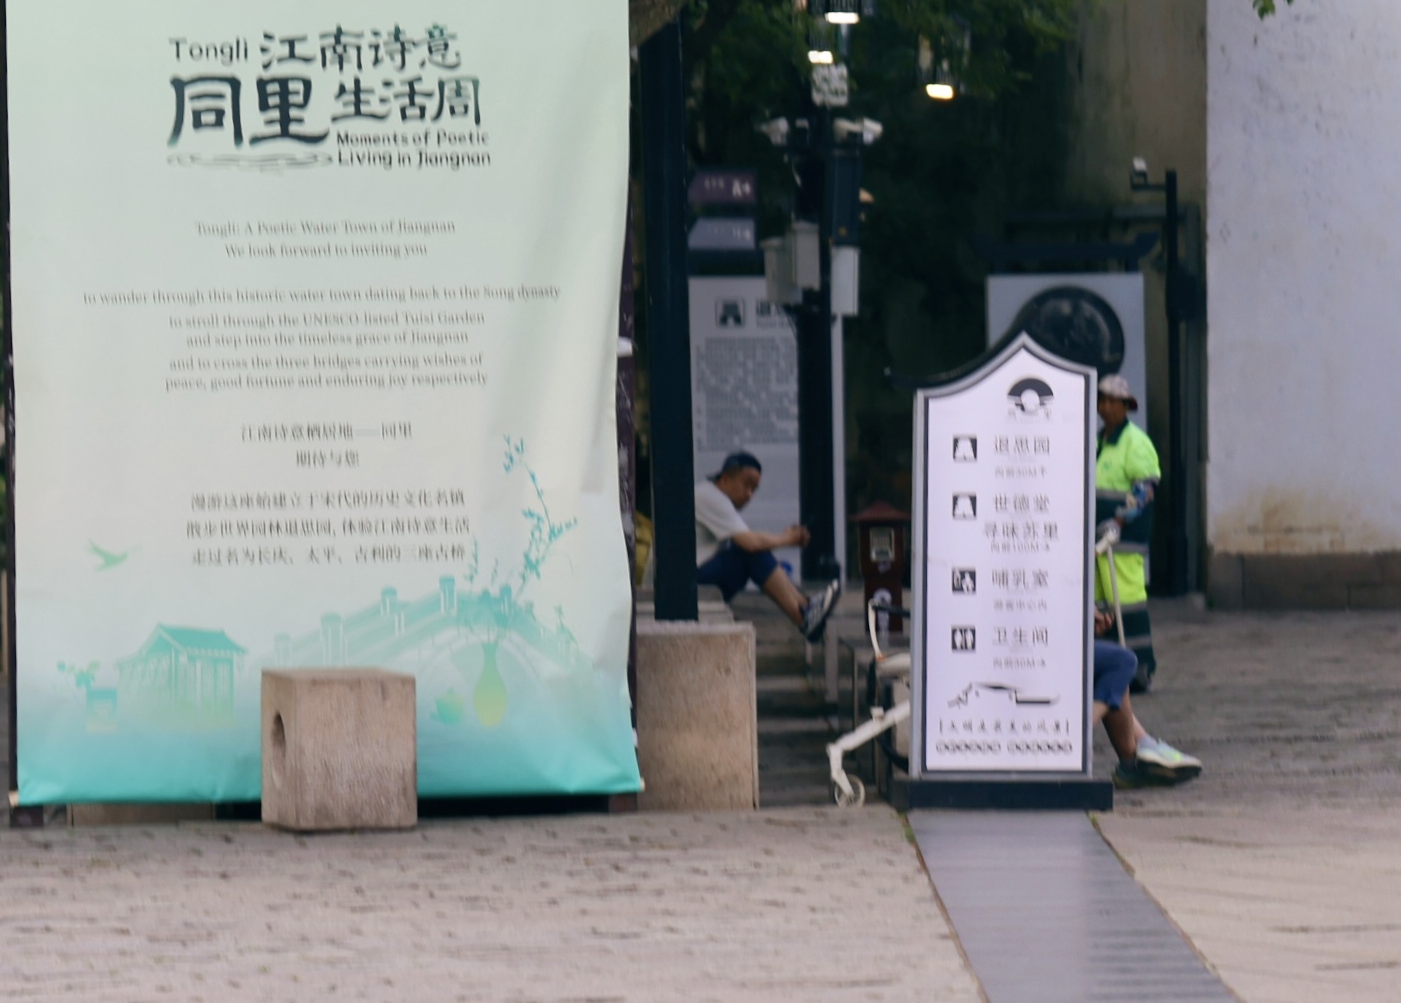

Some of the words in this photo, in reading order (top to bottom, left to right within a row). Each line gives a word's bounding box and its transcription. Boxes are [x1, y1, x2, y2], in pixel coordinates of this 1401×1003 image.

[169, 36, 248, 65] Tongli
[259, 24, 461, 72] 江南诗意
[168, 74, 330, 147] 同里
[331, 74, 481, 126] 生活周
[337, 131, 408, 147] Moments
[413, 130, 430, 146] of
[437, 129, 489, 146] Poetic
[339, 149, 393, 169] Living
[398, 151, 411, 166] in
[418, 149, 491, 169] Jiangnan
[196, 221, 239, 238] Tongli:
[245, 222, 253, 235] A
[258, 222, 296, 235] Poetic
[301, 221, 337, 235] Water
[345, 220, 377, 234] Town
[381, 220, 394, 234] of
[398, 219, 456, 236] Jiangnan
[225, 244, 244, 258] We
[249, 243, 276, 258] look
[280, 243, 331, 258] forward
[335, 245, 348, 257] to
[352, 242, 400, 259] inviting
[404, 245, 427, 258] you
[84, 292, 96, 305] to
[100, 289, 147, 305] wander
[153, 288, 205, 306] through
[209, 288, 233, 303] this
[237, 288, 286, 303] historic
[290, 289, 324, 303] water
[329, 289, 361, 302] town
[365, 286, 406, 303] dating
[410, 285, 439, 300] back
[444, 288, 456, 300] to
[460, 285, 480, 299] the
[484, 285, 514, 302] Song
[518, 283, 560, 302] dynasty
[169, 315, 182, 328] to
[186, 313, 218, 328] stroll
[223, 312, 274, 330] through
[279, 312, 299, 327] the
[303, 312, 360, 326] UNESCO
[364, 310, 399, 326] listed
[403, 311, 434, 325] Tuisi
[438, 310, 485, 325] Garden
[187, 332, 211, 347] and
[215, 334, 242, 350] step
[246, 332, 271, 346] into
[275, 331, 295, 346] the
[299, 330, 352, 346] timeless
[356, 332, 390, 347] grace
[394, 330, 407, 344] of
[411, 329, 469, 346] Jiangnan
[170, 355, 194, 371] and
[198, 357, 211, 370] to
[214, 359, 247, 370] cross
[252, 354, 272, 369] the
[276, 353, 310, 369] three
[314, 353, 361, 370] bridges
[365, 354, 419, 369] carrying
[423, 351, 466, 368] wishes
[470, 352, 483, 366] of
[165, 376, 207, 393] peace,
[211, 374, 242, 392] good
[247, 374, 295, 389] fortune
[298, 373, 322, 388] and
[326, 373, 385, 389] enduring
[389, 372, 408, 389] joy
[412, 369, 487, 388] respectively
